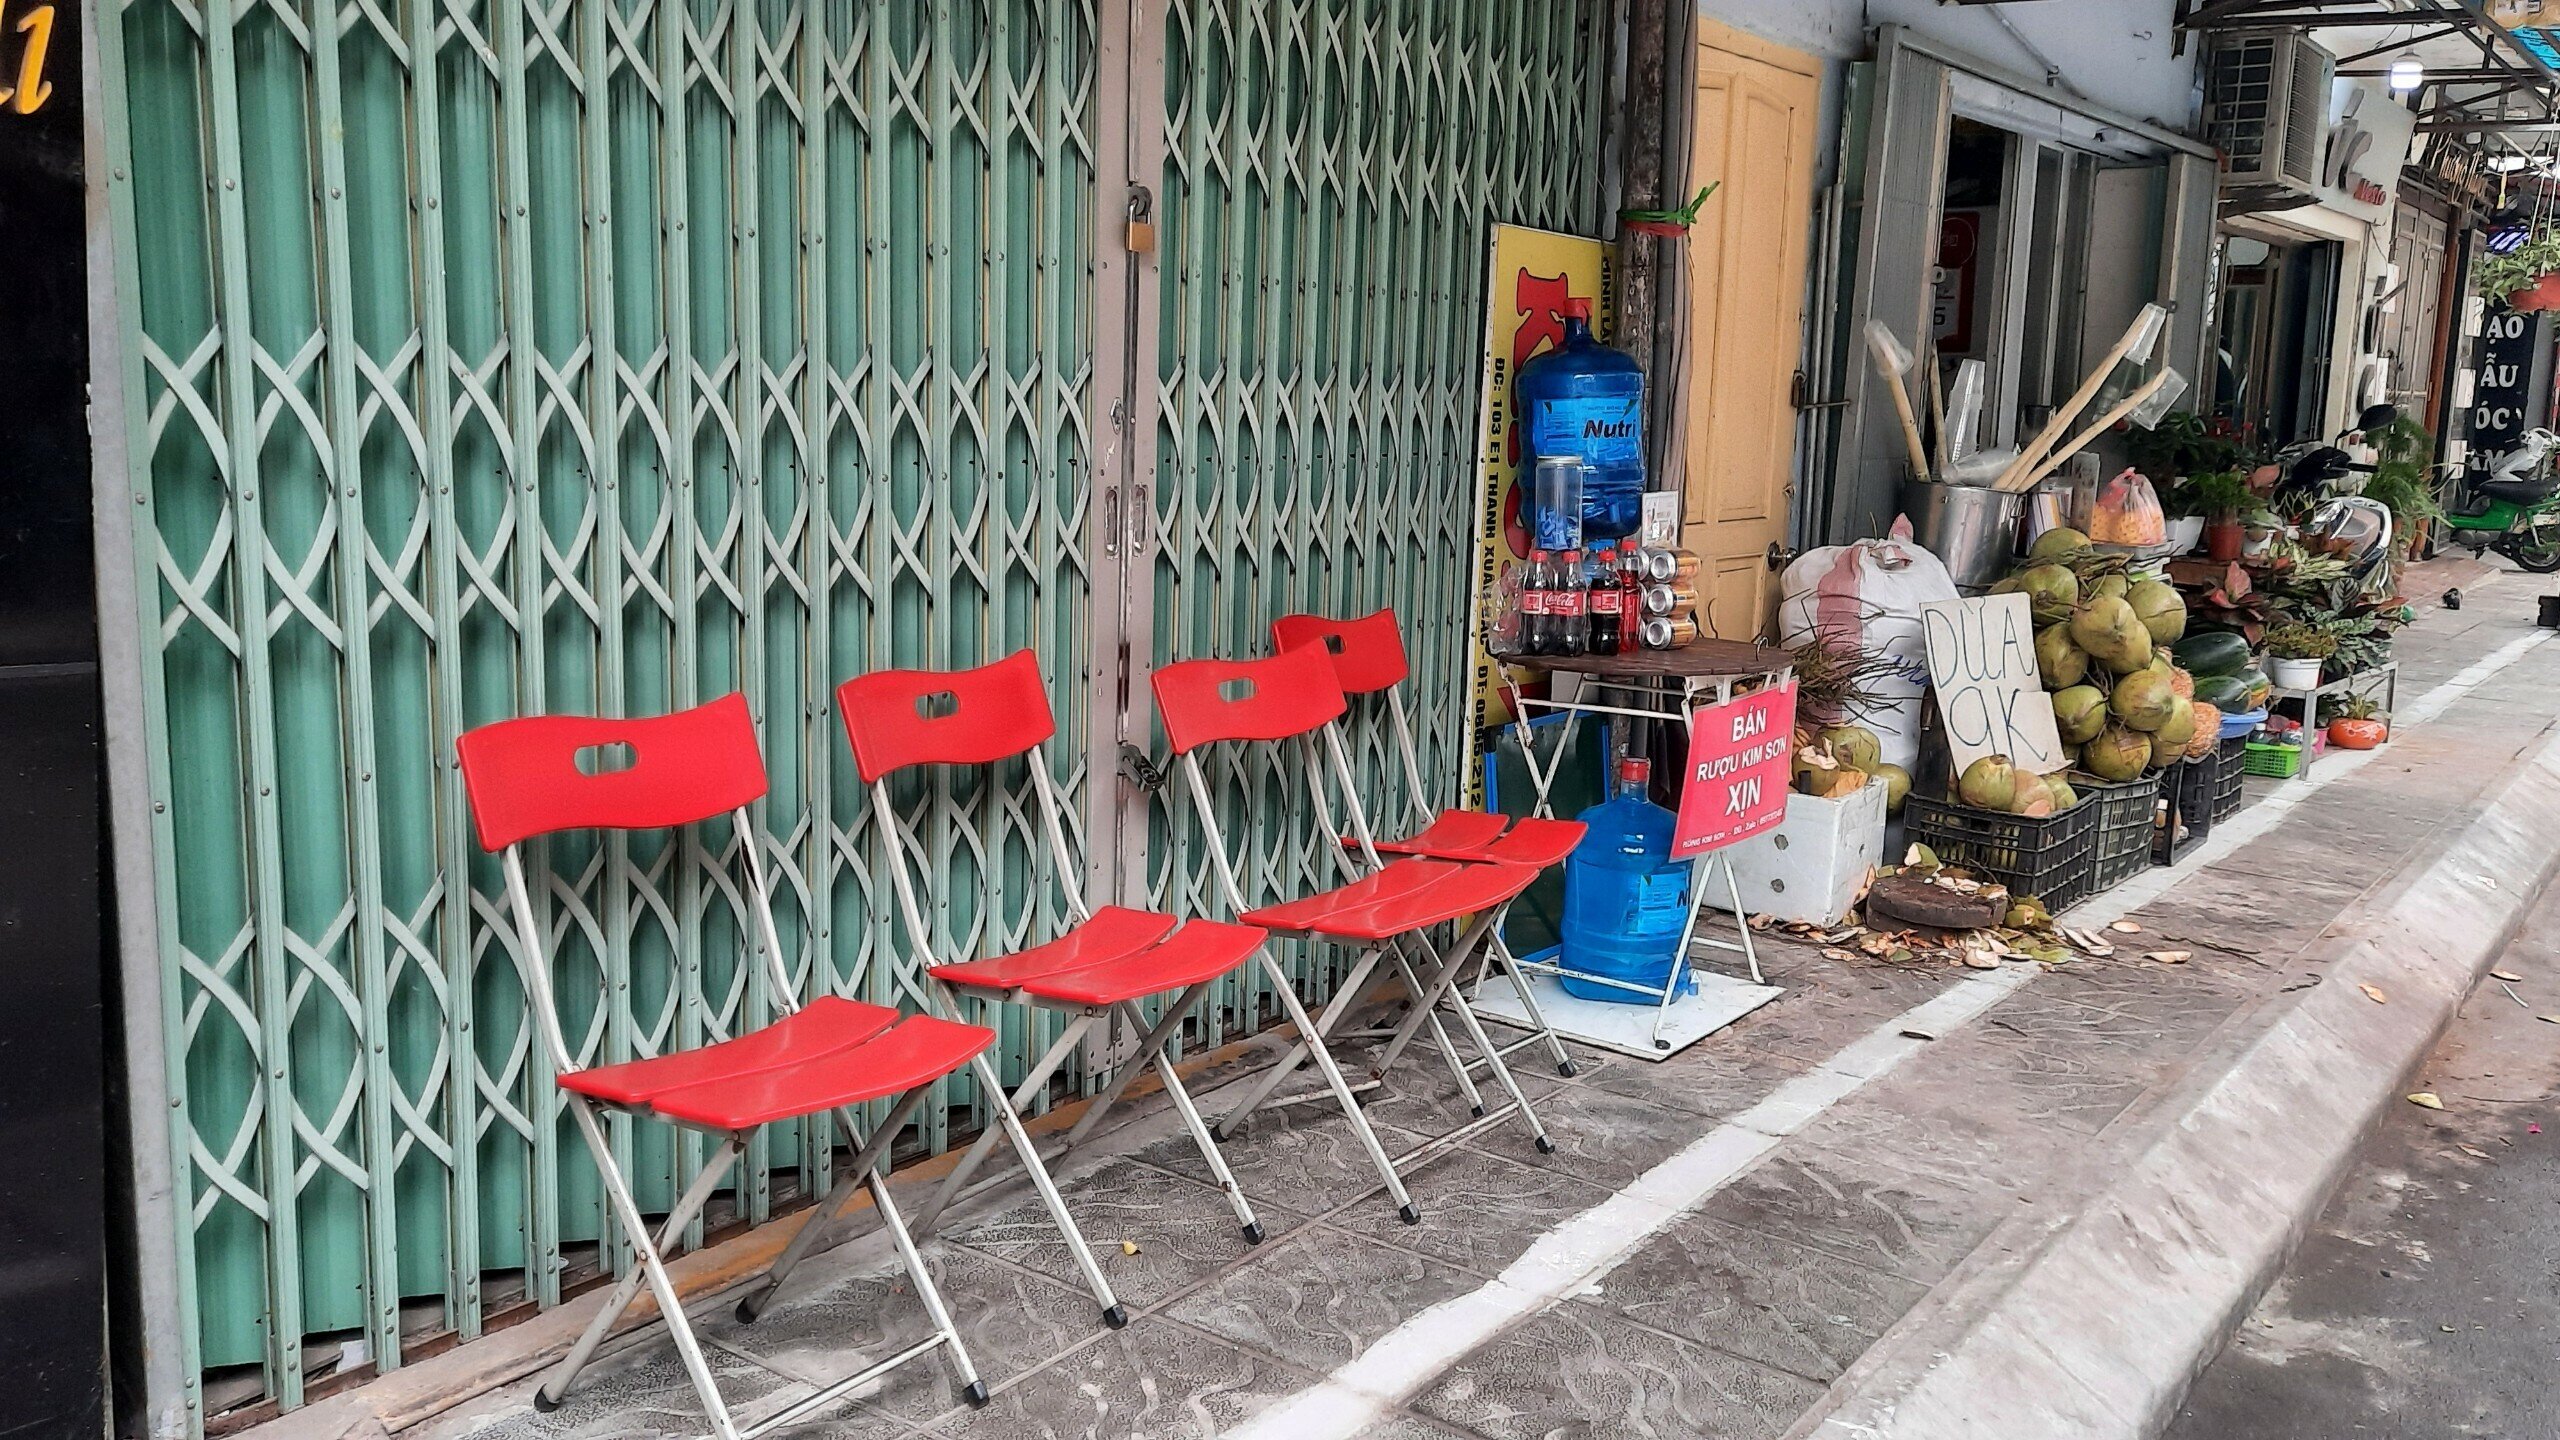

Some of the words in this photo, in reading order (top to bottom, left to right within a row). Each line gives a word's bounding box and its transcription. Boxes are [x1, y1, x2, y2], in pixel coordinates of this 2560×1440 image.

[2486, 315, 2524, 344] ẠO
[2480, 352, 2519, 388] ẪU
[1491, 399, 1503, 435] 103
[1582, 419, 1636, 439] Nutri
[2475, 400, 2510, 430] ÓC
[1489, 441, 1501, 464] E1
[1485, 472, 1499, 538] THANH
[1925, 597, 2034, 688] DỪA
[1731, 705, 1767, 742] BÁN
[1696, 754, 1740, 782] RƯỢU
[1741, 748, 1763, 770] KIM
[1765, 734, 1788, 761] SƠN
[1725, 775, 1762, 818] XỊN
